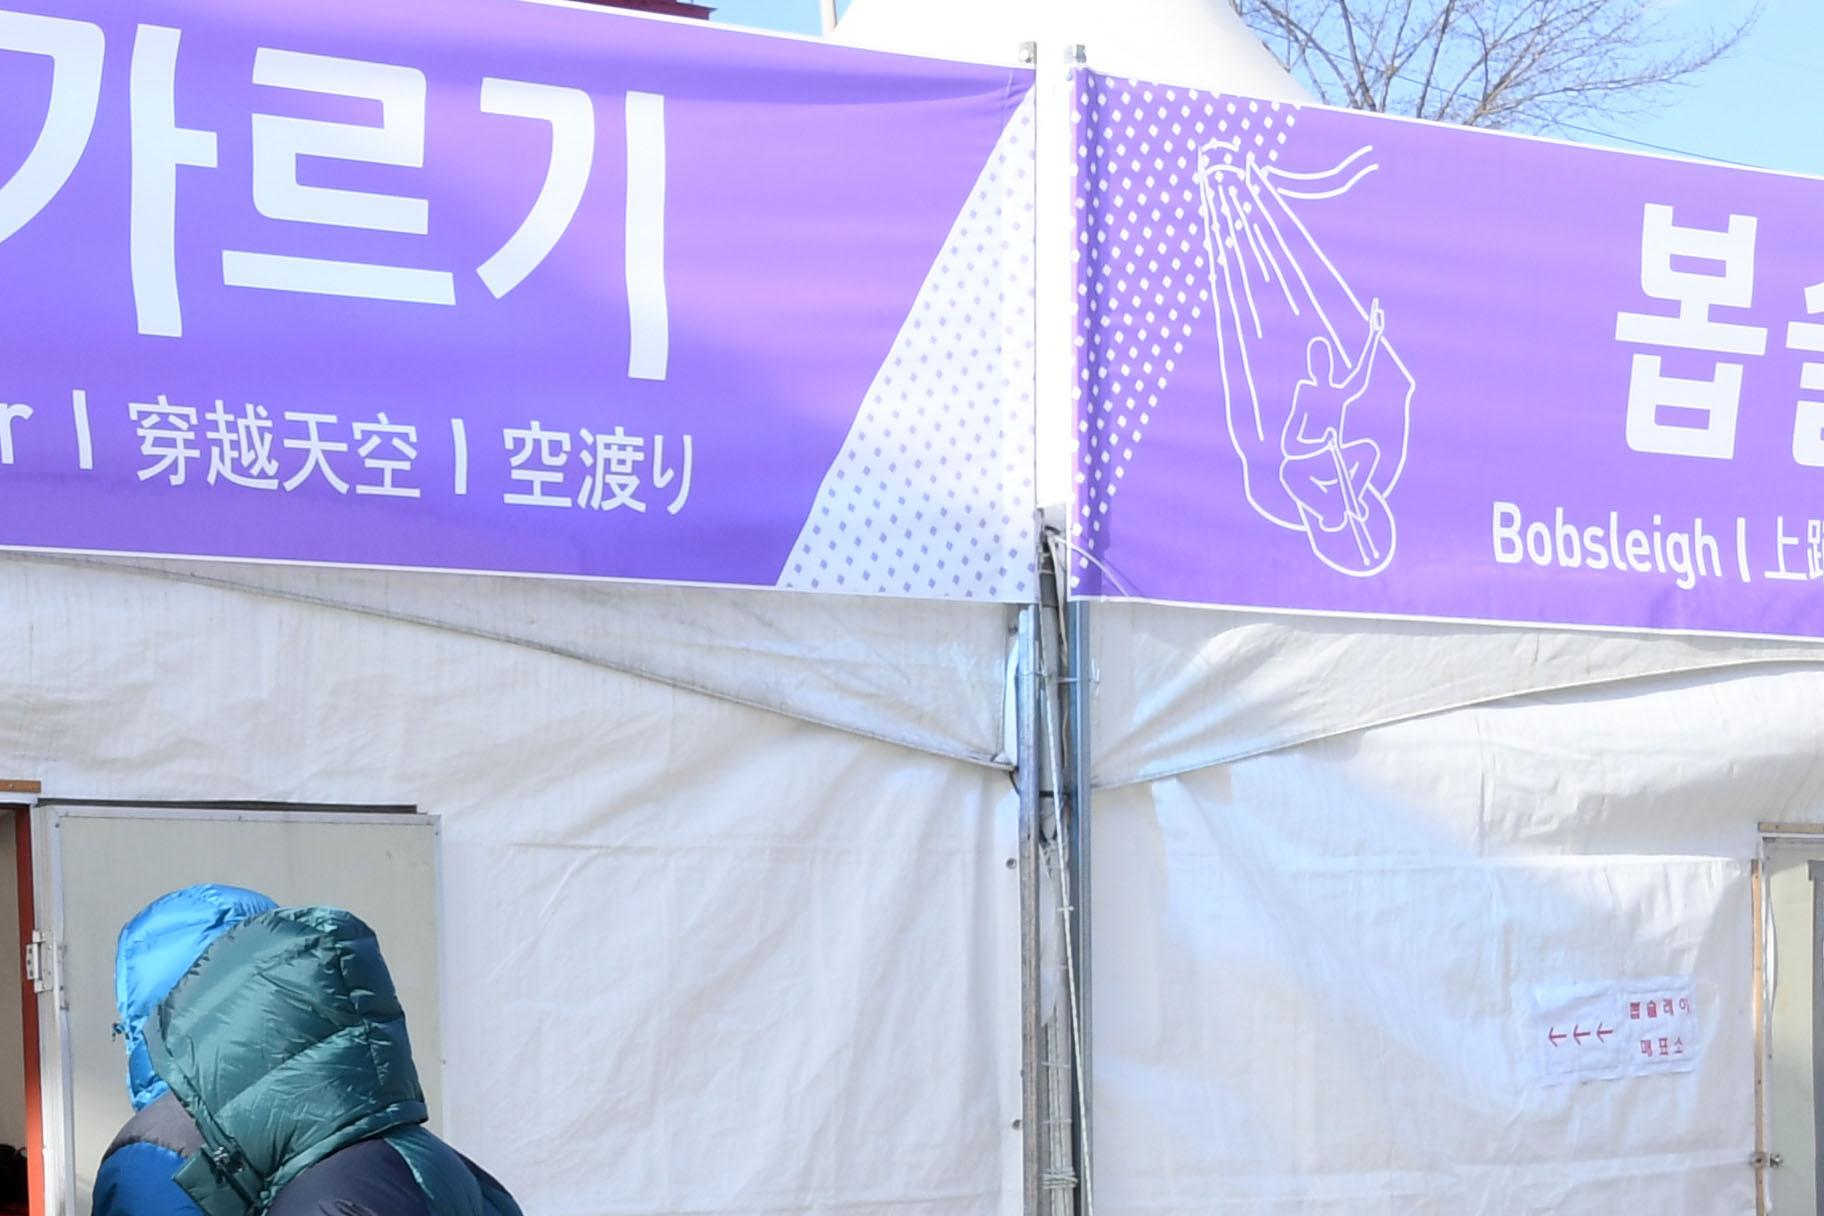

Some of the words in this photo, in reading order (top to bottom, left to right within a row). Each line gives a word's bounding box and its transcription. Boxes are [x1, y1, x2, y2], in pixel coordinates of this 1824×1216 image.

[128, 394, 421, 498] 穿越天空
[503, 420, 693, 515] 空渡り
[1491, 501, 1724, 590] Bobsleigh
[1640, 1037, 1685, 1057] 매표소
